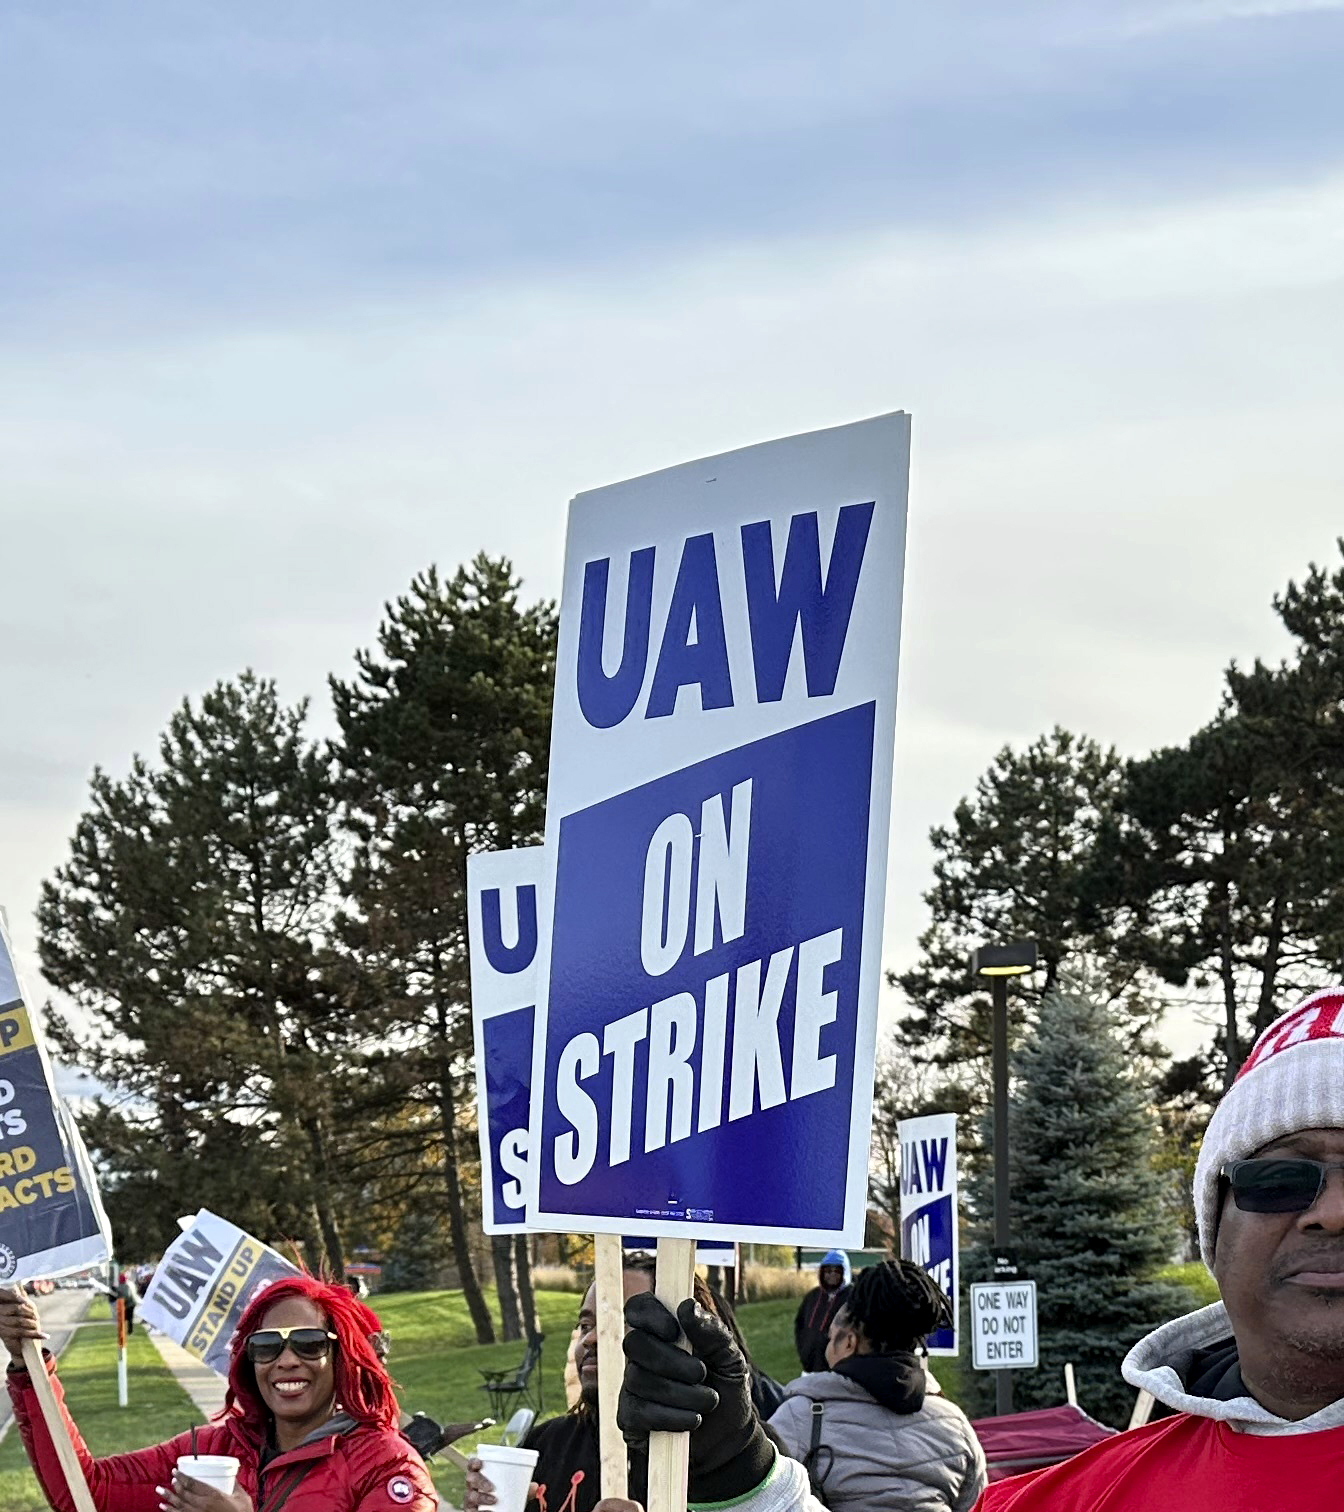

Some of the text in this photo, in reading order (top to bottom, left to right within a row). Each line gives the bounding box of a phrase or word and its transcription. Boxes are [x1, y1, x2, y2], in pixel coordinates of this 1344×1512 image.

[576, 501, 875, 730] UAW
[640, 777, 753, 978] ON
[553, 927, 843, 1187] STRIKE
[901, 1136, 948, 1197] UAW
[152, 1228, 224, 1321] UAW
[910, 1213, 931, 1267] ON
[191, 1280, 237, 1352] STAND
[230, 1246, 254, 1278] UP
[977, 1290, 1029, 1311] ONE WAY
[982, 1315, 1026, 1335] DO NOT
[987, 1340, 1024, 1360] ENTER
